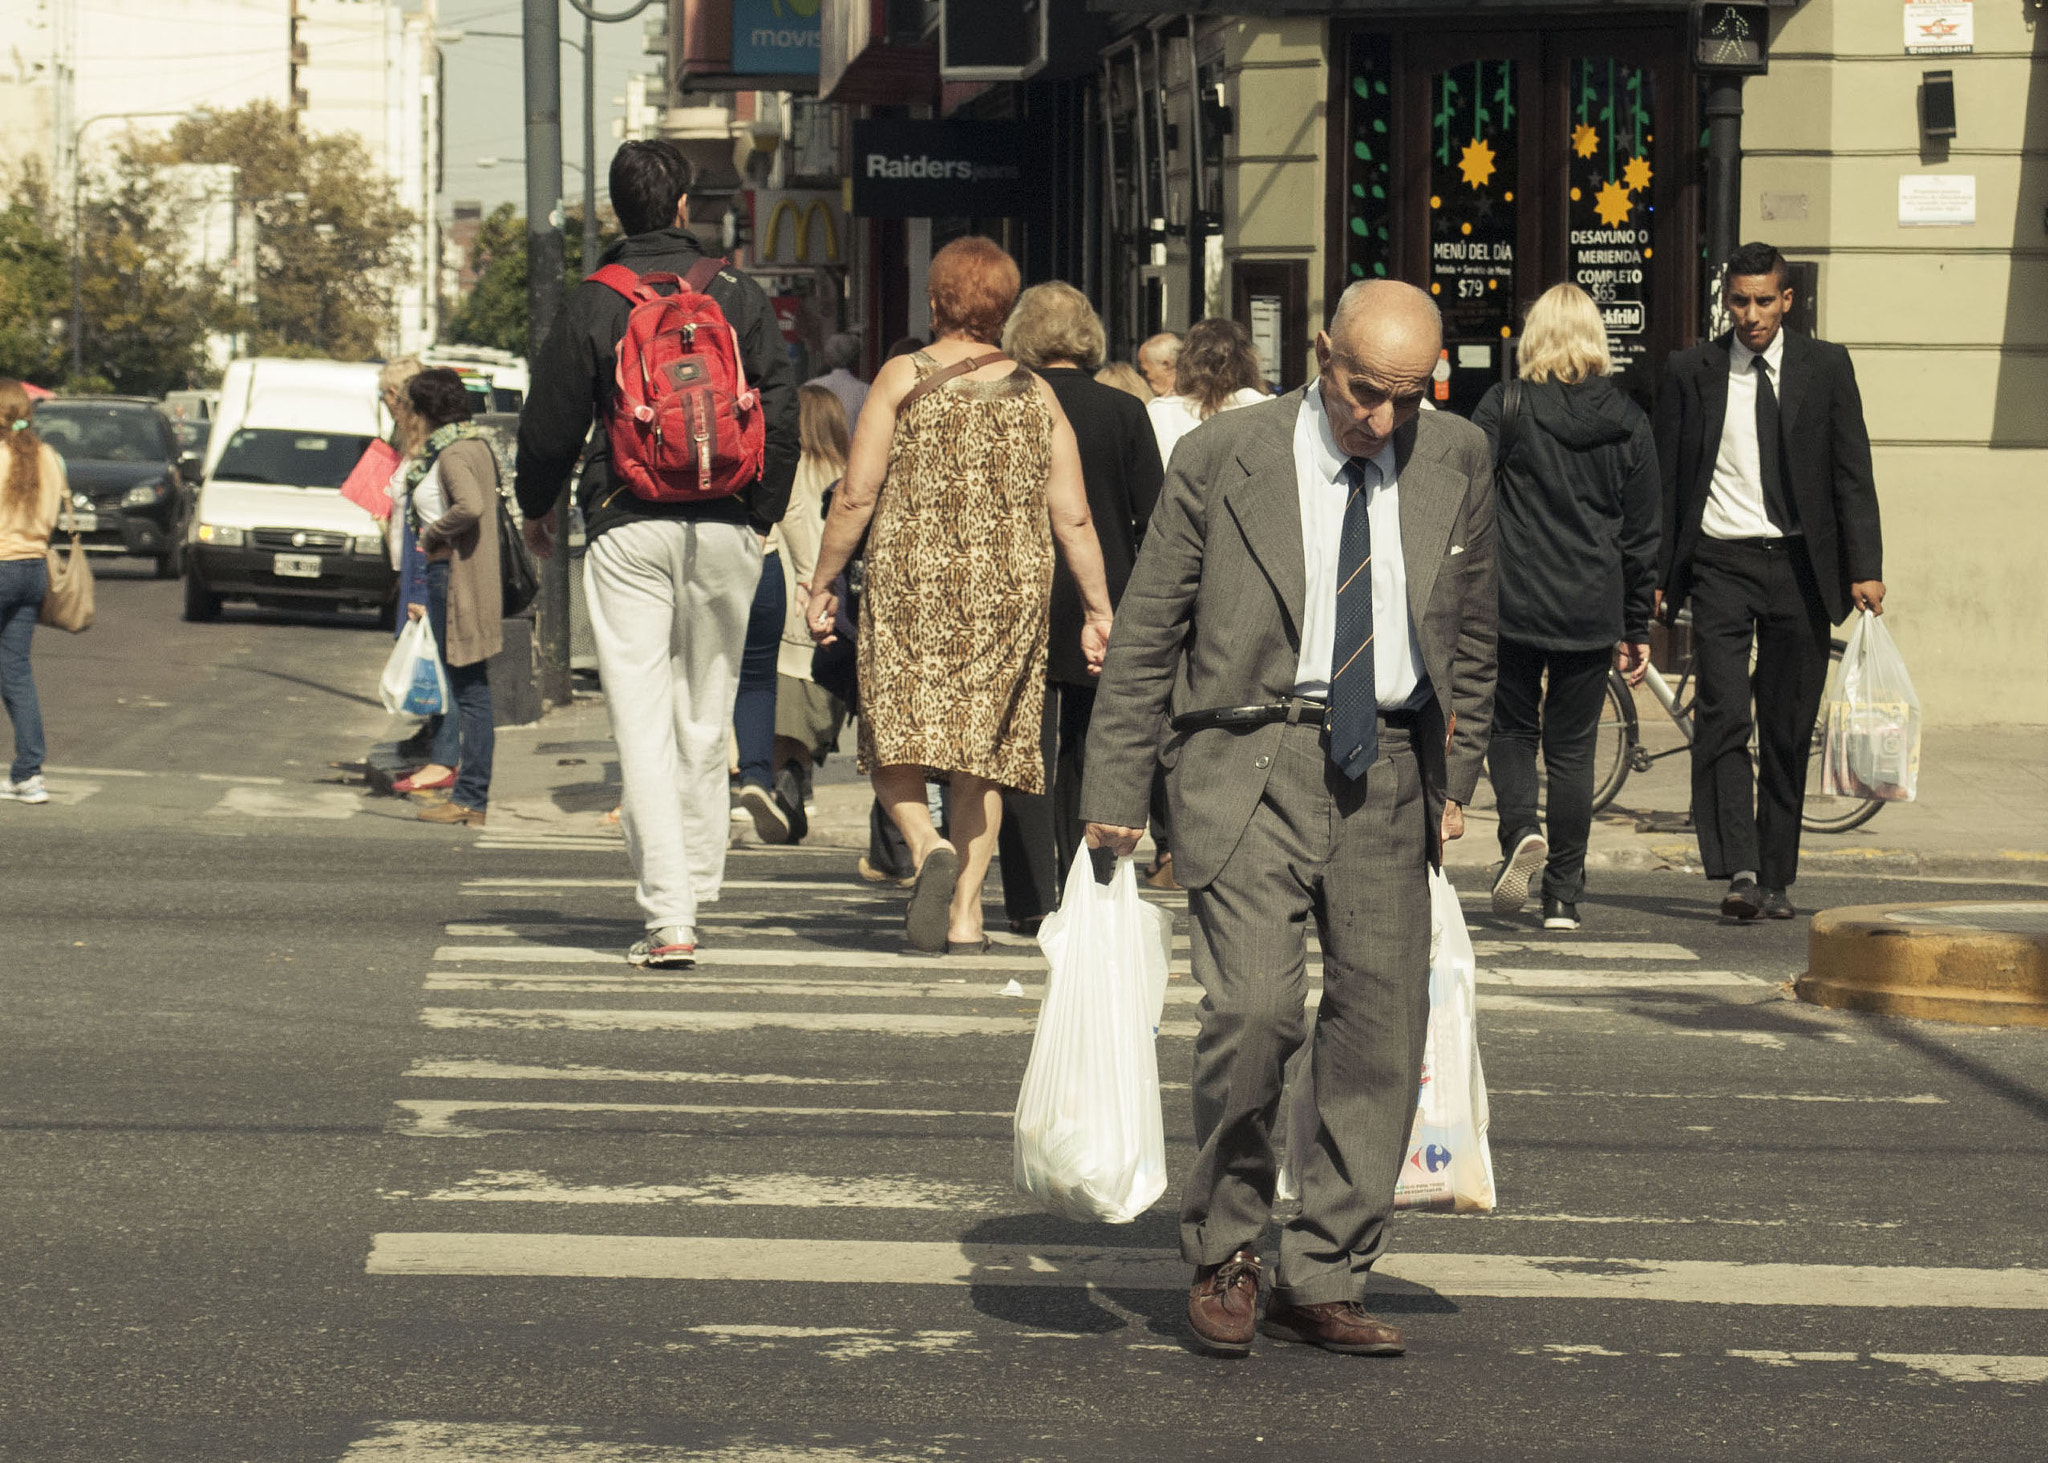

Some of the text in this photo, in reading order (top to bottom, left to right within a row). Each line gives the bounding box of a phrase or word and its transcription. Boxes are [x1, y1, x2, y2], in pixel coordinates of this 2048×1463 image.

[866, 153, 972, 180] Raiders
[1570, 230, 1649, 245] DESAYUNO O
[1433, 239, 1512, 260] MENÚ DEL DÍA
[1577, 249, 1642, 264] MERIENDA
[1576, 269, 1643, 284] COMPLETO
[1458, 278, 1484, 298] $79
[1591, 283, 1617, 301] $65
